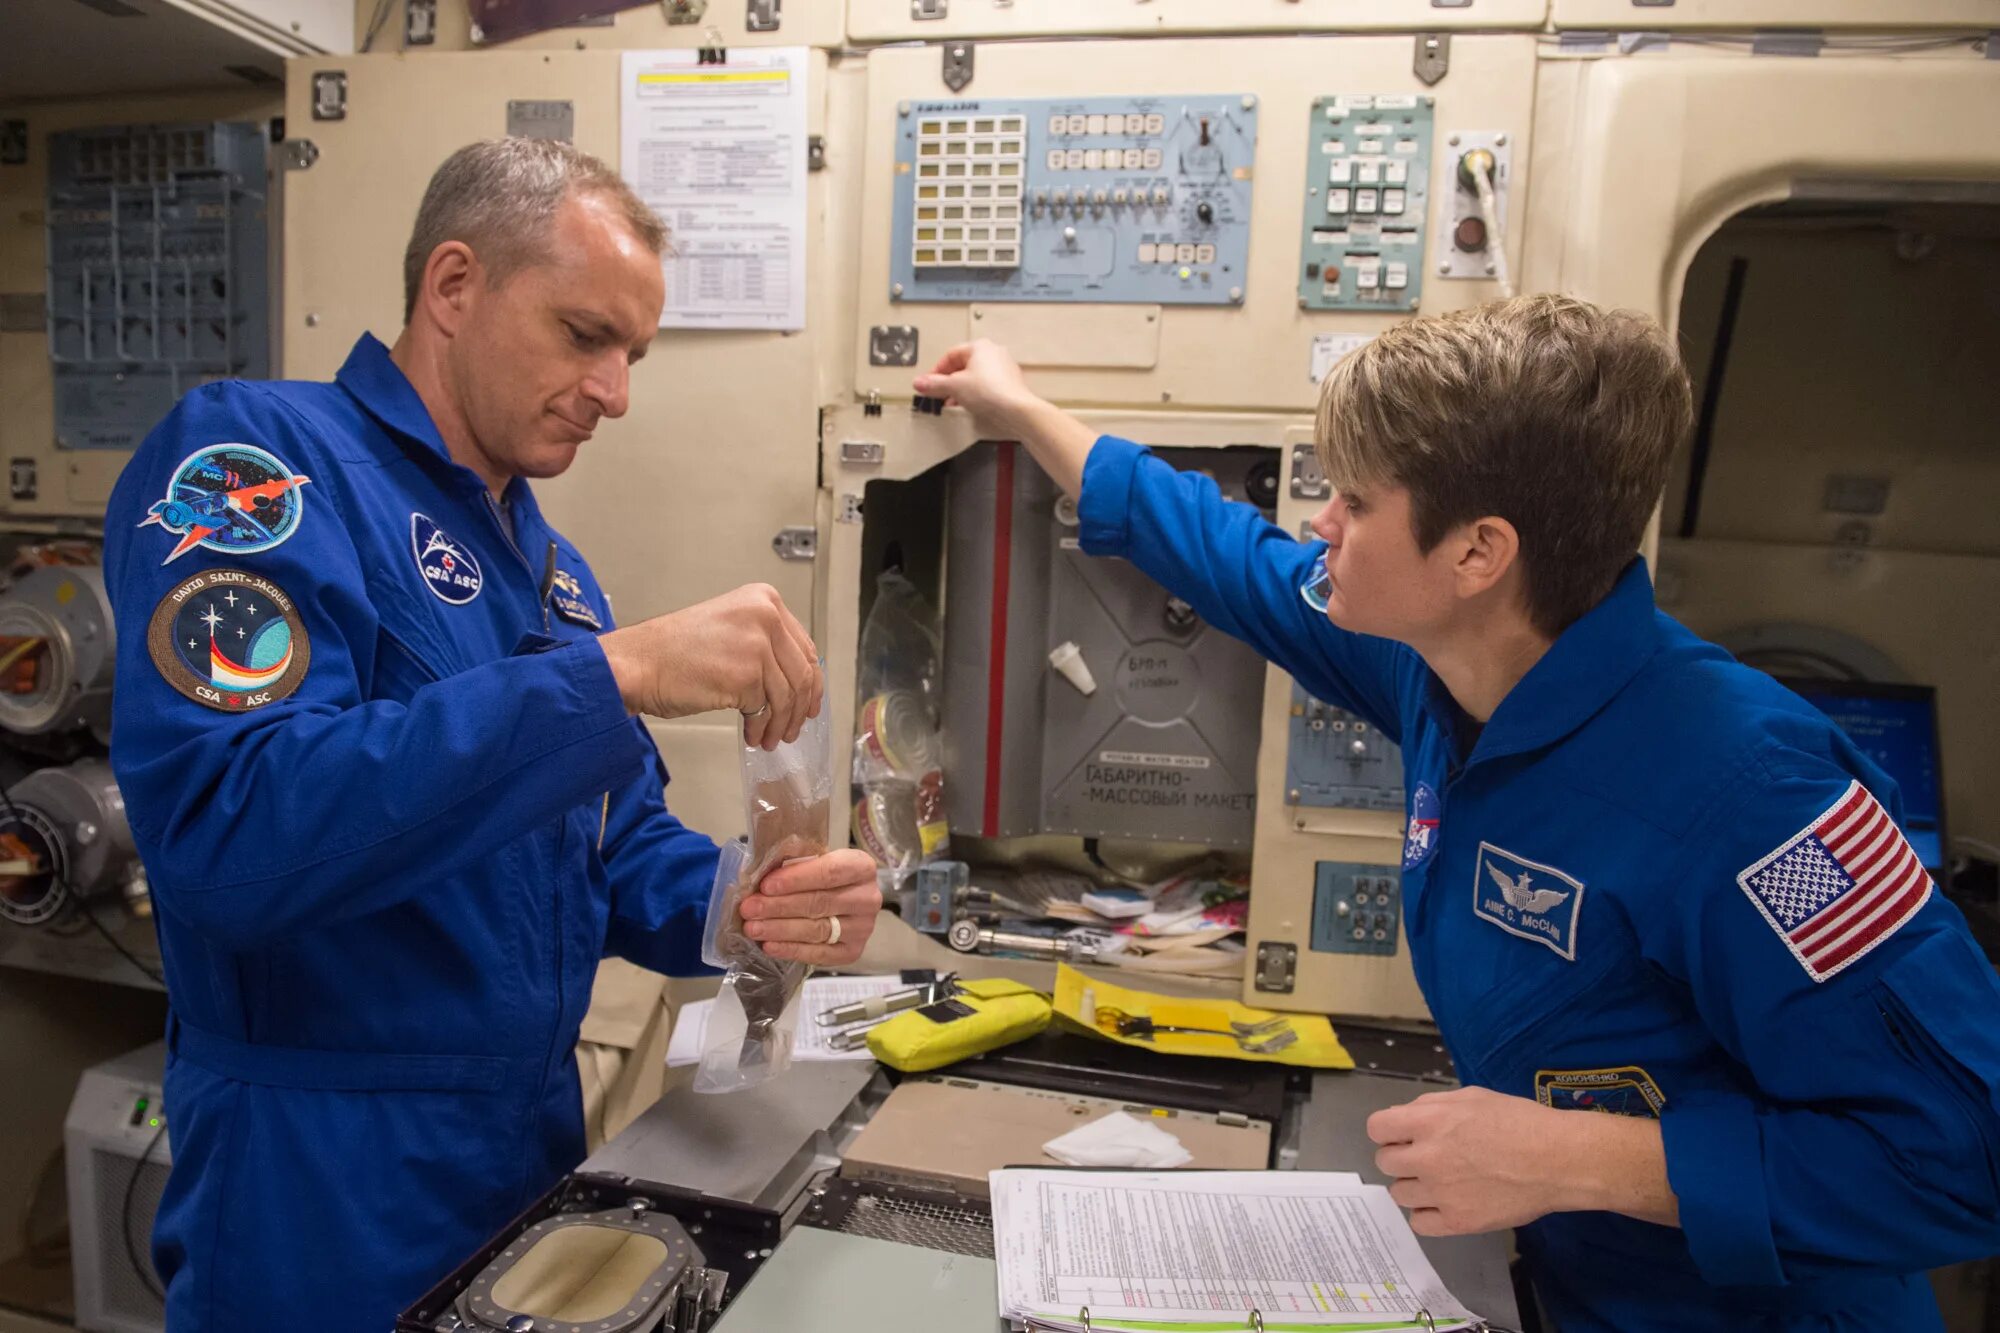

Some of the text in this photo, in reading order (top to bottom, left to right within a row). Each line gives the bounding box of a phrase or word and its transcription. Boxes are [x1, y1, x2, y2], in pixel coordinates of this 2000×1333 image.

[425, 565, 479, 590] CSA ASC
[172, 572, 292, 612] DAVID SAINT-JACQUES
[195, 686, 272, 707] CSA ASC
[1085, 764, 1191, 786] ГАБАРИТНО-
[1194, 792, 1256, 811] МАКЕТ
